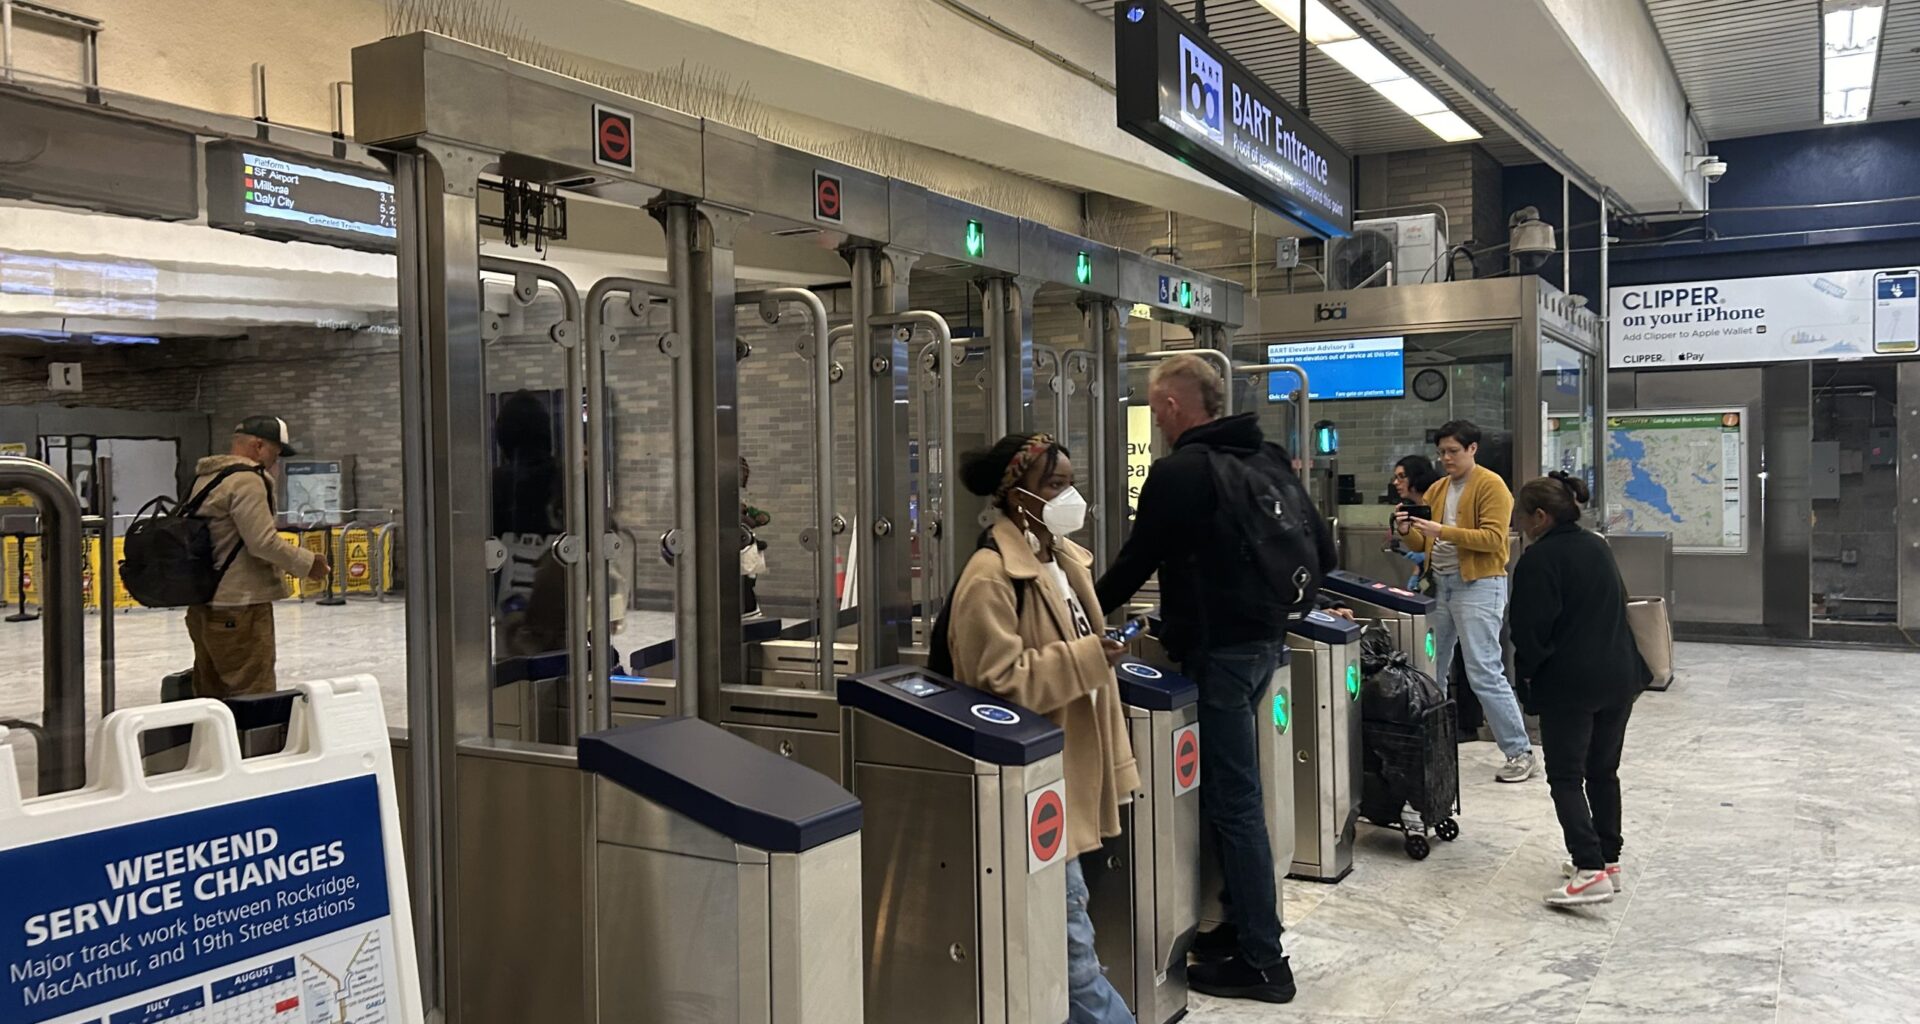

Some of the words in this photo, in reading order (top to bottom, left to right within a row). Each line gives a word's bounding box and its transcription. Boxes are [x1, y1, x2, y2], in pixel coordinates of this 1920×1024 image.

[1194, 56, 1220, 83] BART
[1232, 82, 1272, 146] BART
[1275, 115, 1328, 186] Entrance
[254, 157, 285, 169] Platform
[254, 166, 267, 177] SF
[268, 171, 300, 185] Airport
[1233, 132, 1251, 158] Proof
[1251, 146, 1259, 163] of
[1305, 181, 1323, 205] beyond
[1332, 200, 1344, 217] point
[253, 179, 290, 195] Millbrae
[254, 192, 276, 207] Daly
[277, 195, 295, 209] City
[1623, 313, 1646, 327] on
[1650, 312, 1693, 329] your
[1697, 306, 1766, 323] iPhone
[1623, 333, 1642, 342] Add
[1644, 331, 1676, 341] Clipper
[1679, 330, 1689, 338] to
[1692, 328, 1720, 338] Apple
[1722, 327, 1753, 336] Wallet
[1288, 345, 1316, 353] Elevator
[1317, 342, 1347, 351] Advisory
[1686, 352, 1704, 362] Pay
[105, 827, 278, 890] WEEKEND
[24, 880, 184, 947] SERVICE
[193, 840, 345, 901] CHANGES
[9, 952, 75, 984] Major
[80, 933, 133, 964] track
[137, 918, 188, 947] work
[193, 898, 271, 932] between
[276, 874, 360, 909] Rockridge,
[23, 959, 142, 1007] MacArthur,
[148, 942, 185, 970] and
[191, 932, 234, 956] 19th
[239, 914, 289, 943] Street
[294, 897, 355, 926] stations
[233, 965, 274, 986] AUGUST
[144, 998, 171, 1014] JULY
